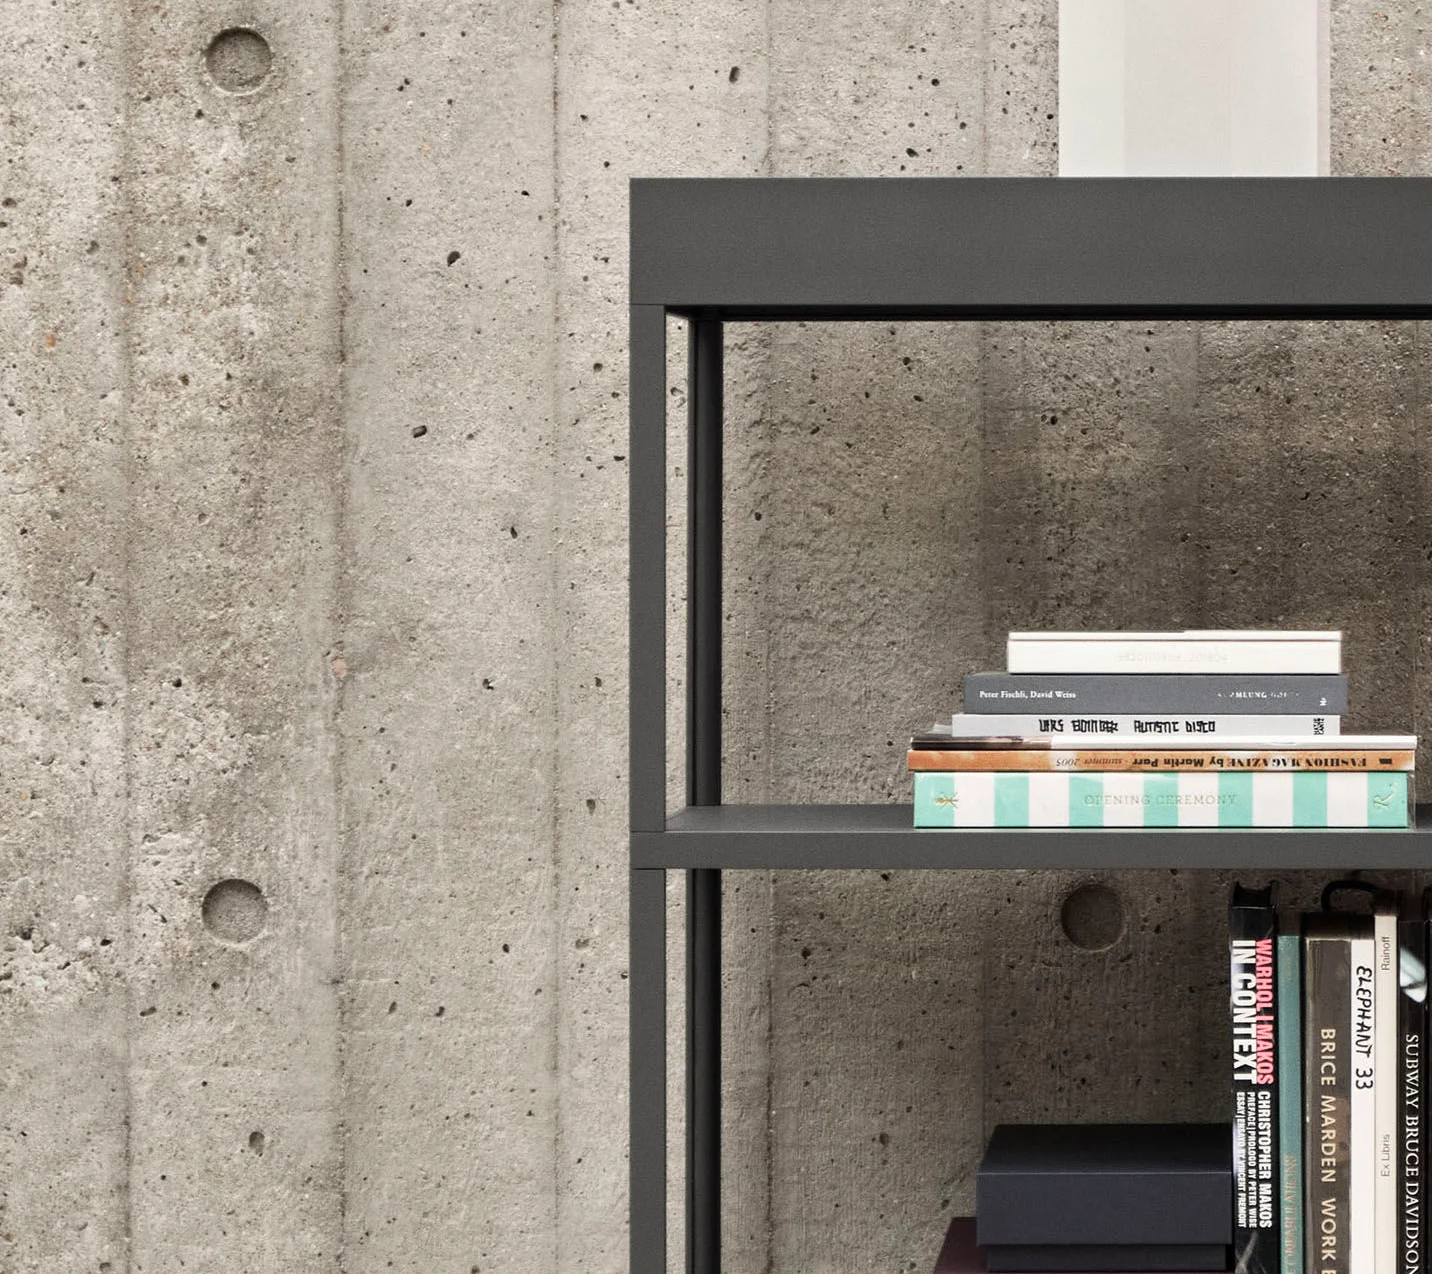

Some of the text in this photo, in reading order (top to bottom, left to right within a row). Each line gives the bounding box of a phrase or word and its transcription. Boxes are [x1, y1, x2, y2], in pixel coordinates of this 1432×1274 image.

[979, 690, 1076, 700] Peter Fischli, David Weiss
[1185, 720, 1216, 733] DISCO
[1056, 758, 1080, 767] 2005
[1132, 758, 1158, 768] Parr
[1163, 758, 1205, 768] Martin
[1209, 756, 1224, 768] by
[1227, 758, 1302, 767] MAGAZINE
[1305, 758, 1367, 767] FASHION
[1084, 795, 1237, 806] OPENING CEREMONY
[1380, 935, 1391, 971] Rainoff
[1255, 938, 1274, 1011] WARHOL
[1232, 939, 1257, 1084] IN CONTEXT
[1355, 965, 1374, 1090] ELEPHANT 33
[1256, 1025, 1274, 1085] MAKOS
[1320, 1028, 1337, 1086] BRICE
[1405, 1034, 1420, 1109] SUBWAY
[1320, 1095, 1337, 1183] MARDEN
[1380, 1134, 1391, 1162] Libris
[1405, 1115, 1420, 1177] BRUCE
[1257, 1091, 1273, 1228] CHRISTOPHER MAKOS
[1380, 1163, 1391, 1177] Ex
[1237, 1160, 1246, 1186] VINCENT
[1247, 1168, 1256, 1180] BY
[1247, 1181, 1256, 1205] PETER
[1237, 1187, 1246, 1228] FREMONT
[1248, 1206, 1257, 1228] WISE
[1321, 1198, 1337, 1262] WORK
